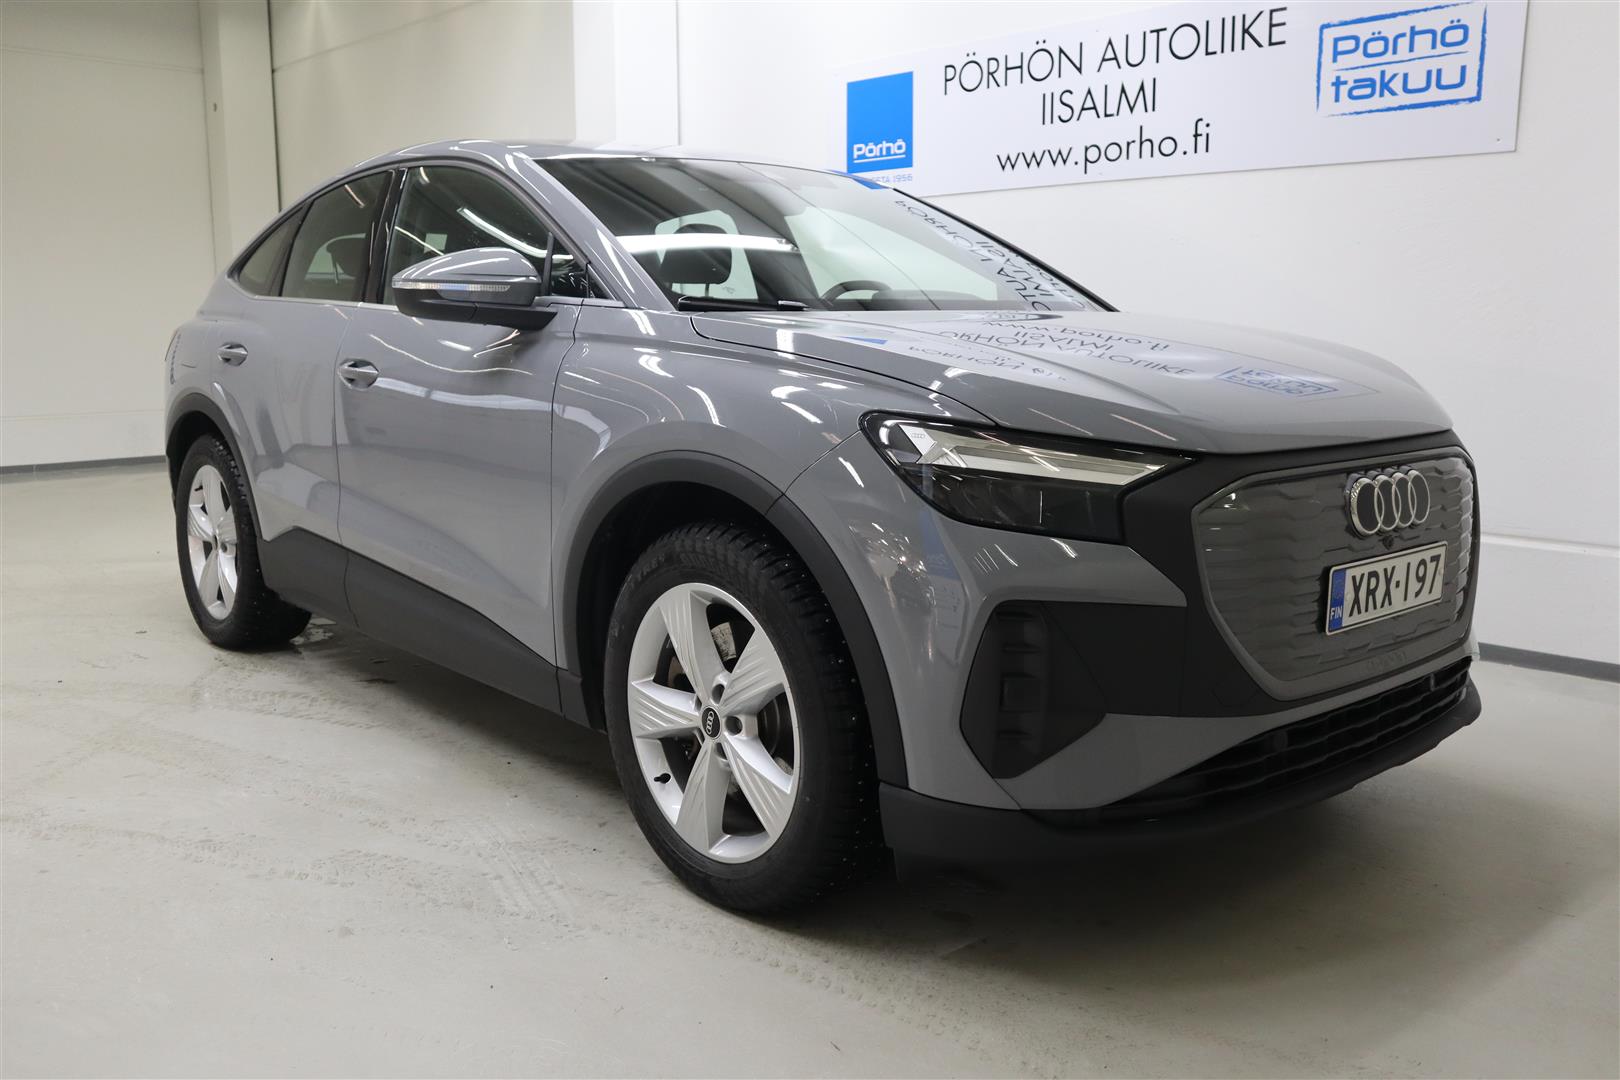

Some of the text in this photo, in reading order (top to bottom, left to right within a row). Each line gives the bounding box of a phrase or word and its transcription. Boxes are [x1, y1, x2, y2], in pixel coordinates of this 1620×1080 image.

[944, 7, 1288, 96] PÖRHÖN AUTOLIIKE
[1331, 19, 1470, 63] Pörhö
[1042, 78, 1157, 126] IISALMI
[1331, 64, 1468, 103] takuu
[853, 139, 906, 159] Pörhö
[996, 118, 1211, 175] www.porho.fi
[1330, 554, 1441, 620] FIN XRX-197
